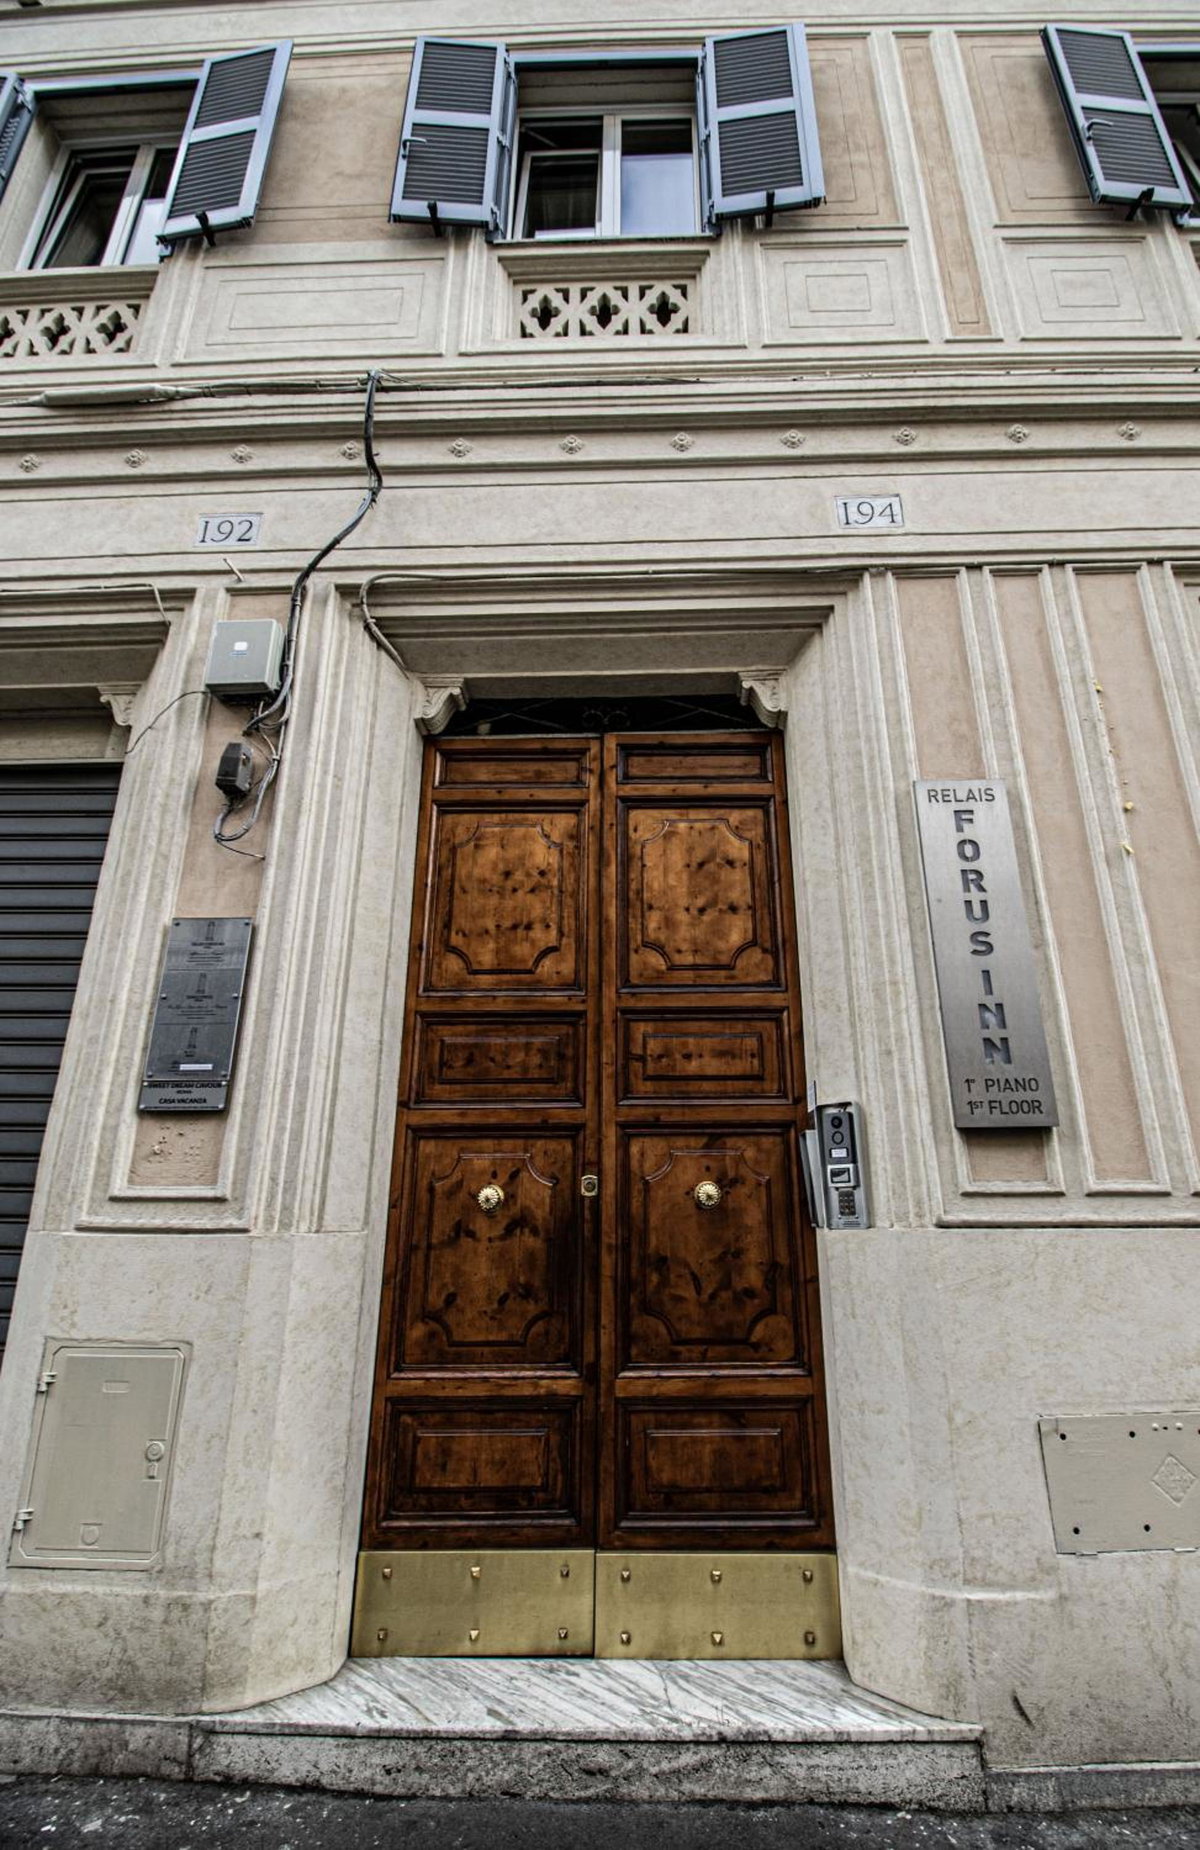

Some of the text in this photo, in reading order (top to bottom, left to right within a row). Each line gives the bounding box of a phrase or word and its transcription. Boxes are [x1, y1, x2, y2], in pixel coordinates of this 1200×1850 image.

[842, 501, 898, 525] 194
[199, 519, 253, 543] 192
[927, 788, 996, 803] RELAIS
[984, 1077, 1040, 1093] PIANO
[967, 1100, 1044, 1115] 1ST FLOOR
